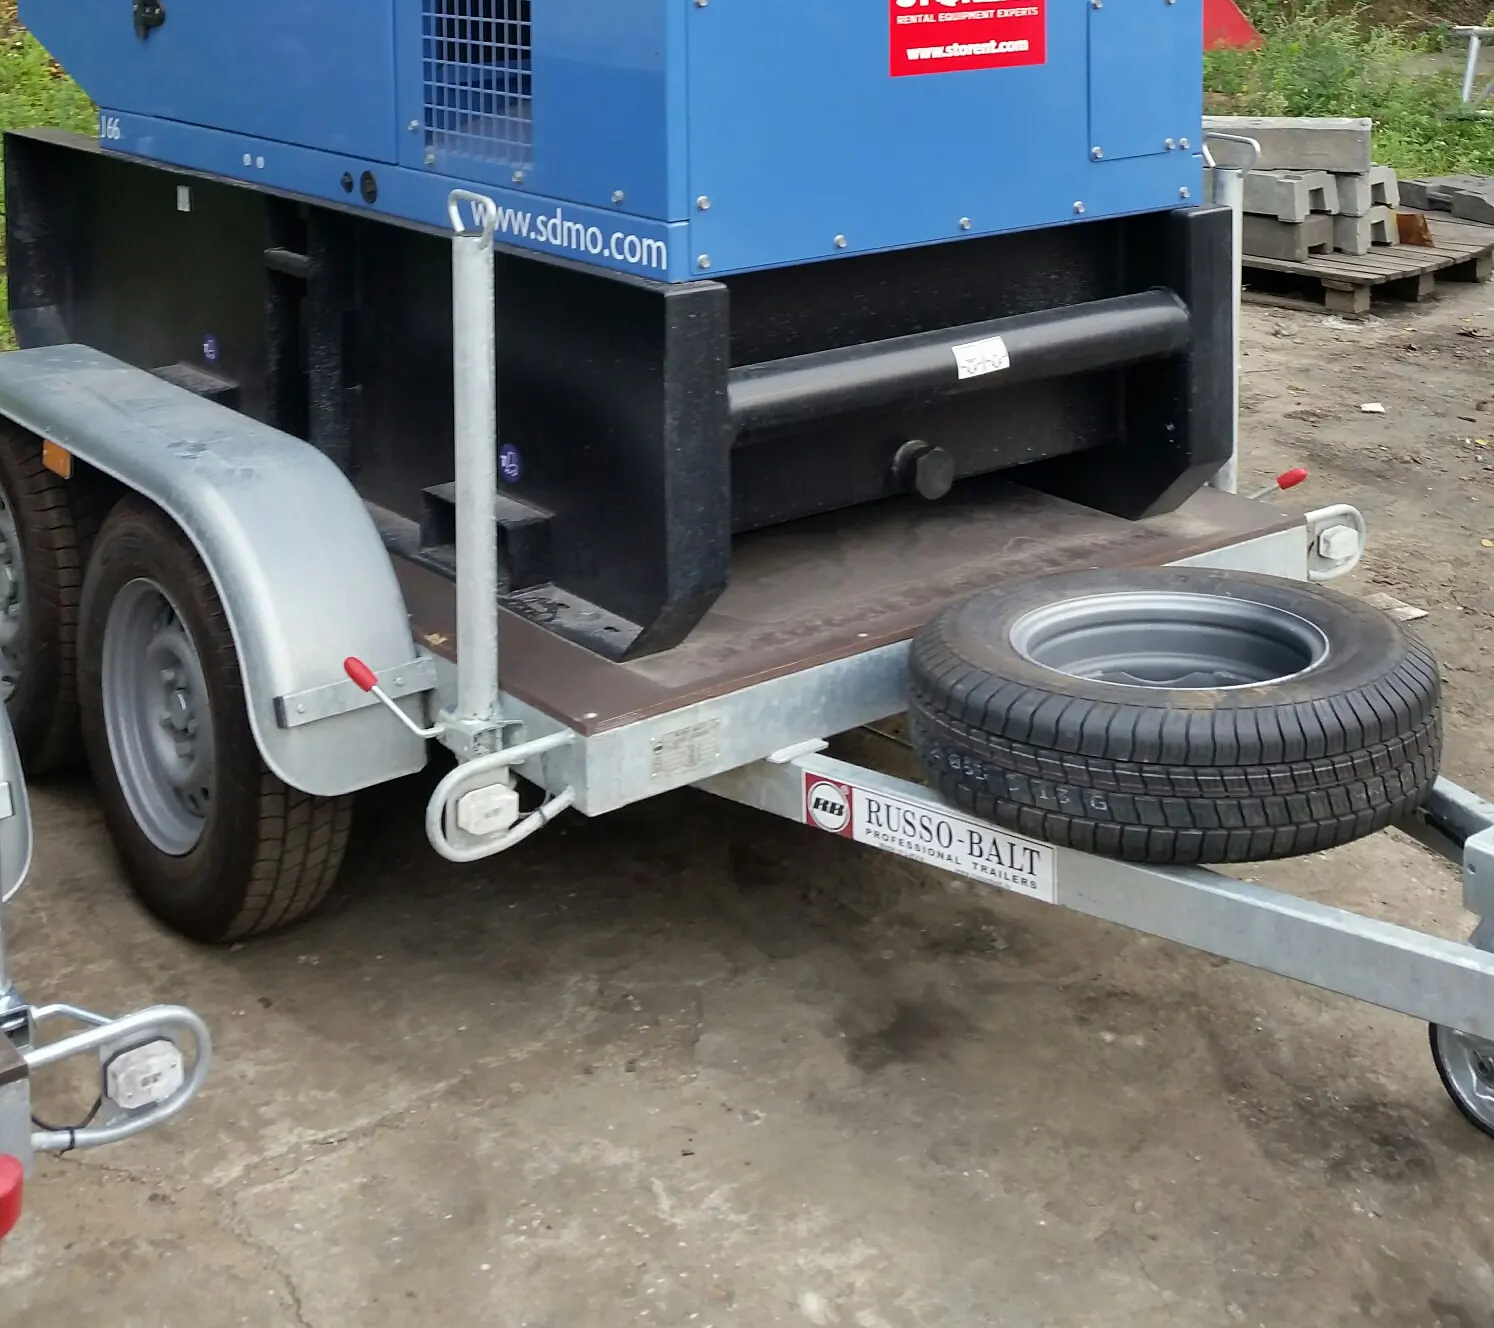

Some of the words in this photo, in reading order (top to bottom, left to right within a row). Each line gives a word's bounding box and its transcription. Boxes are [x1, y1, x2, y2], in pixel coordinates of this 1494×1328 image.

[896, 13, 936, 24] RENTAL
[938, 9, 995, 22] EQUIPMENT
[996, 6, 1039, 19] EXPERTS
[906, 39, 1029, 60] www.storent.com
[470, 200, 668, 270] www.sdmo.com
[865, 797, 1041, 877] RUSSO-BALT
[865, 827, 962, 866] PROFESSIONAL
[972, 861, 1037, 890] TRAILERS
